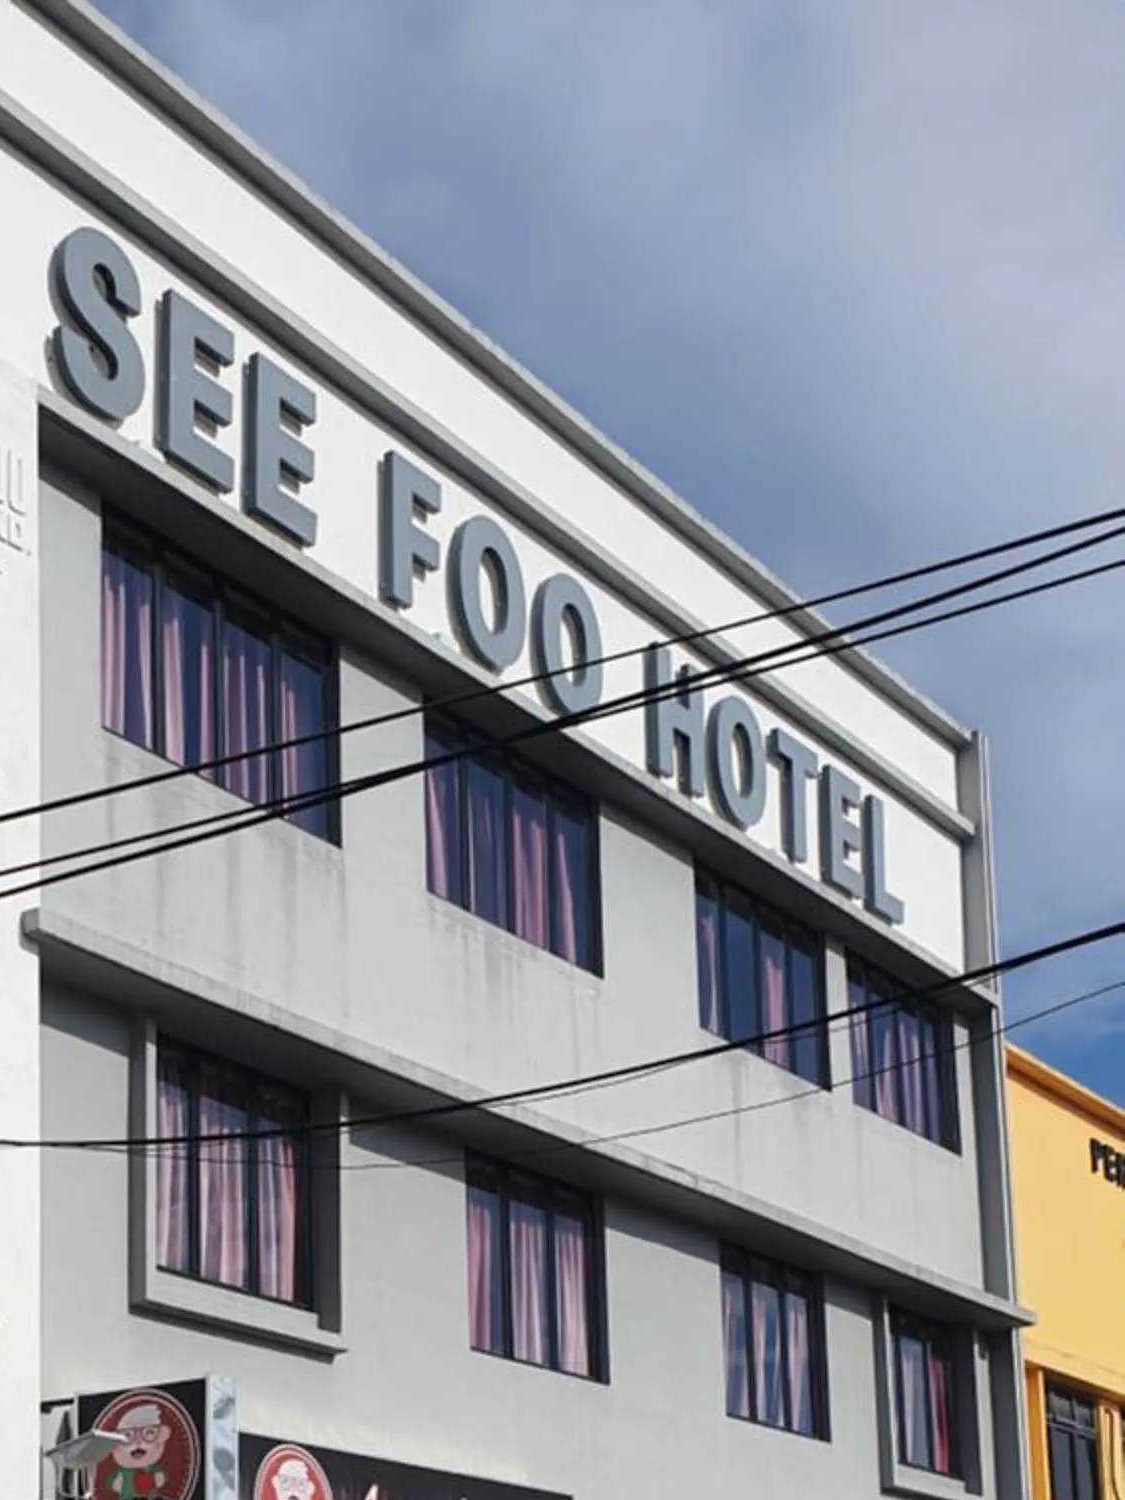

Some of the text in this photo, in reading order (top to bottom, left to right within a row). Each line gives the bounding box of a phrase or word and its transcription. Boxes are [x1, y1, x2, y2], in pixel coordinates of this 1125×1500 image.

[45, 226, 905, 930] SEE FOO HOTEL
